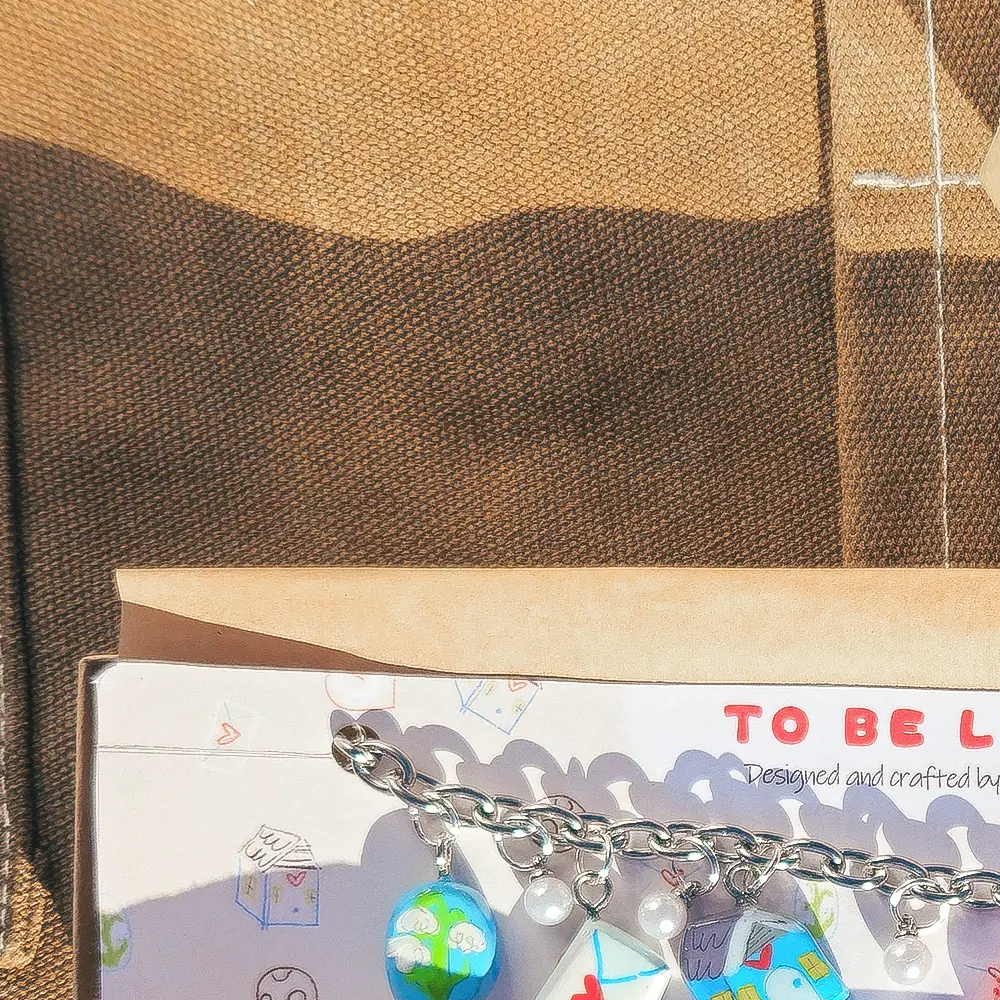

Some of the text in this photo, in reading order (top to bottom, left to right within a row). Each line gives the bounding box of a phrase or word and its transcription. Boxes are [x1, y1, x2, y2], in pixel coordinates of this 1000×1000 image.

[723, 704, 810, 745] TO
[844, 707, 926, 748] BE
[744, 762, 841, 794] Designed
[845, 765, 885, 787] and
[889, 766, 971, 789] crafted
